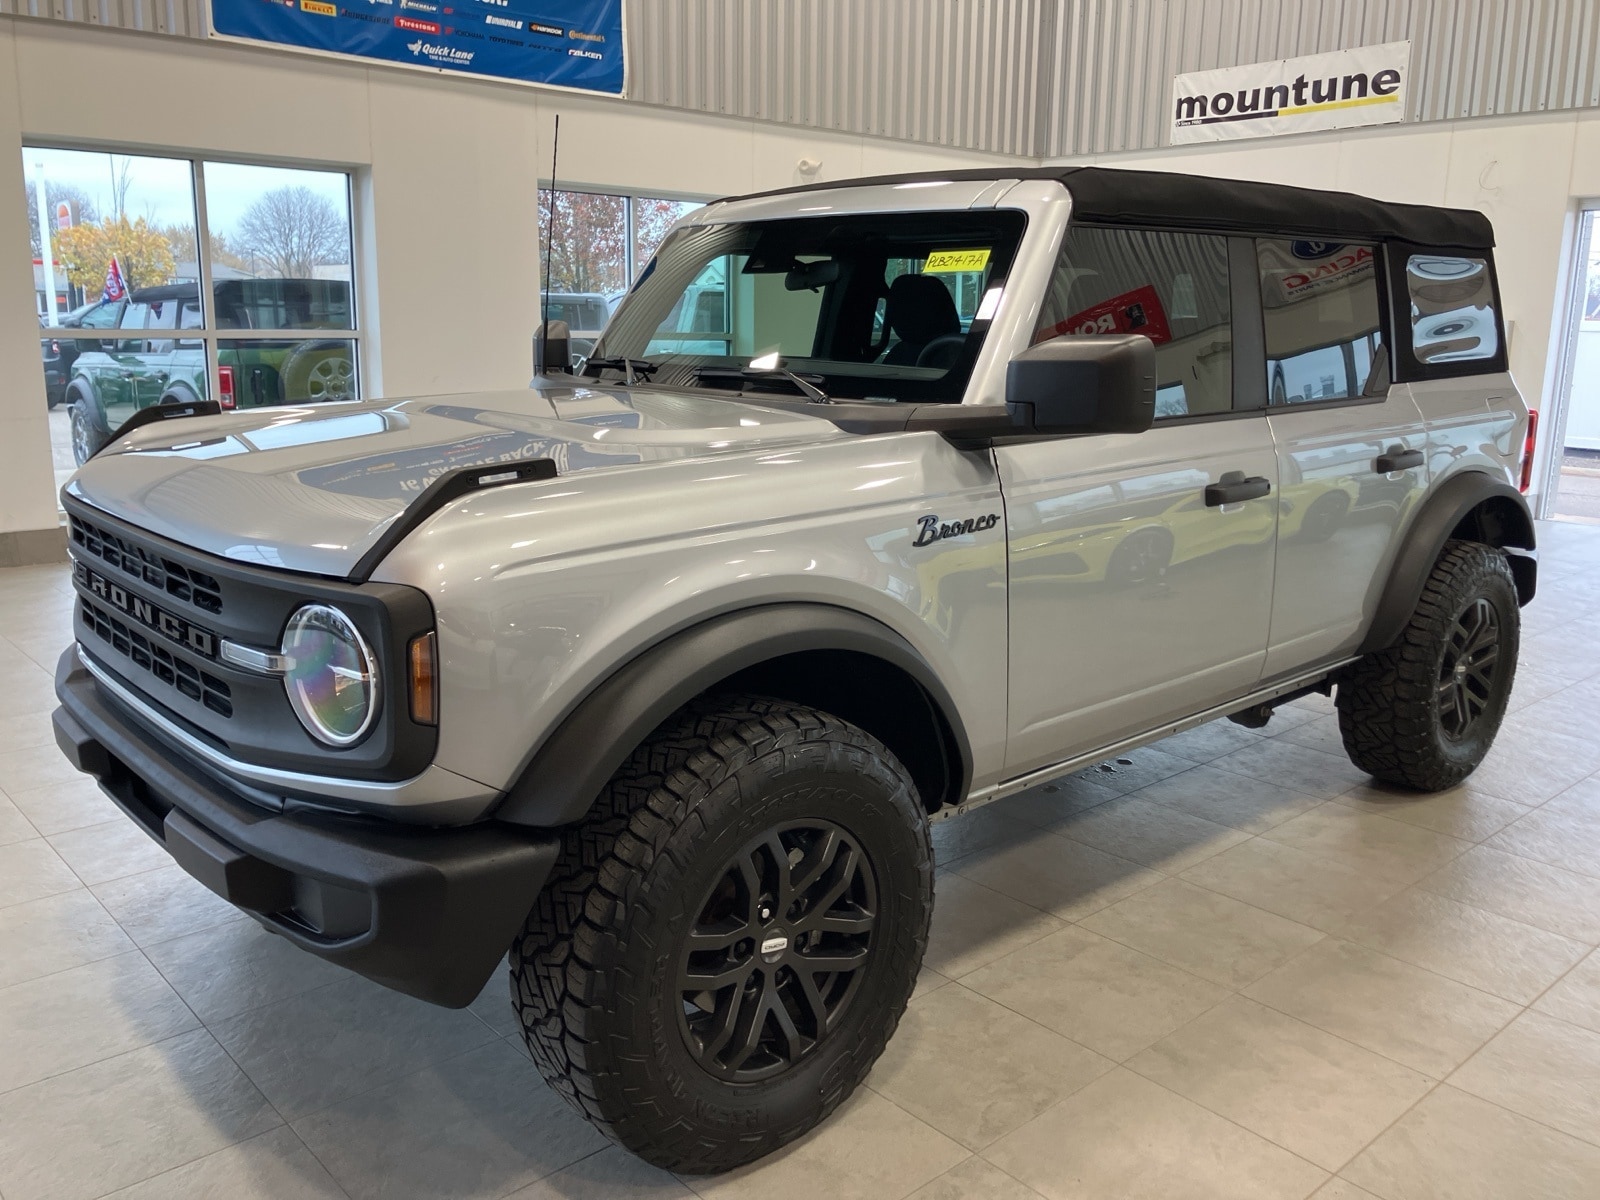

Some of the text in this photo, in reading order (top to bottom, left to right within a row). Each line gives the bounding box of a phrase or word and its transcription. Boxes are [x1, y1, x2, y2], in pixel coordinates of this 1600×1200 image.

[304, 2, 333, 14] PIRELLI
[407, 1, 437, 12] MICHELIN
[422, 43, 474, 60] Quick Lane
[568, 49, 602, 60] FALKEN
[1176, 69, 1401, 120] mountune
[912, 514, 1001, 547] Bronco
[75, 562, 213, 655] BRONCO
